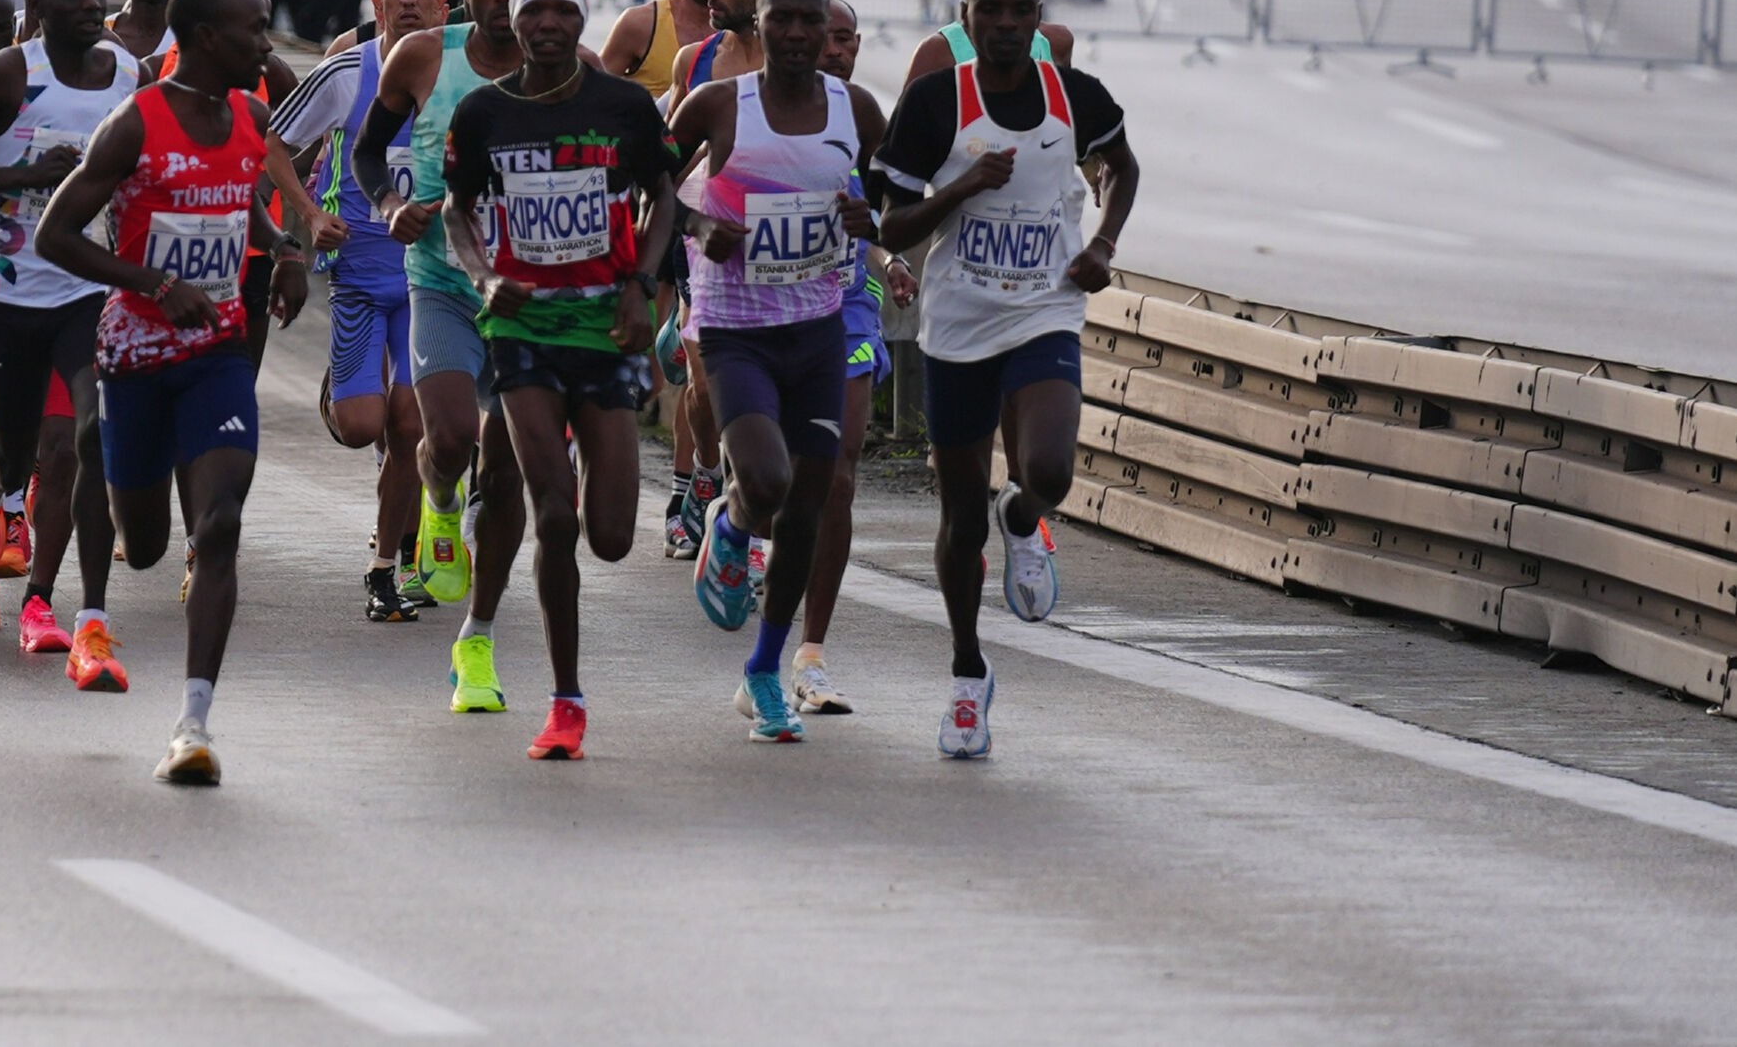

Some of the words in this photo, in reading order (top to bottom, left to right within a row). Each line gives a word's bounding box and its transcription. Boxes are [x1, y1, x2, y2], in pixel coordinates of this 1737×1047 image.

[590, 174, 604, 186] 93
[170, 180, 252, 207] TÜRKİYE
[506, 189, 608, 241] KIPKOGEI
[1050, 208, 1061, 219] 94
[518, 243, 553, 253] ISTANBUL
[554, 238, 602, 252] MARATHON
[748, 212, 840, 261] ALEX
[957, 214, 1061, 270] KENNEDY
[146, 232, 245, 280] LABAN
[755, 263, 795, 274] ISTANBUL
[796, 255, 834, 272] MARATHON
[961, 264, 1001, 280] ISTANBUL
[1001, 269, 1048, 282] MARATHON
[195, 281, 233, 292] ARATHON
[1031, 282, 1051, 292] 2024
